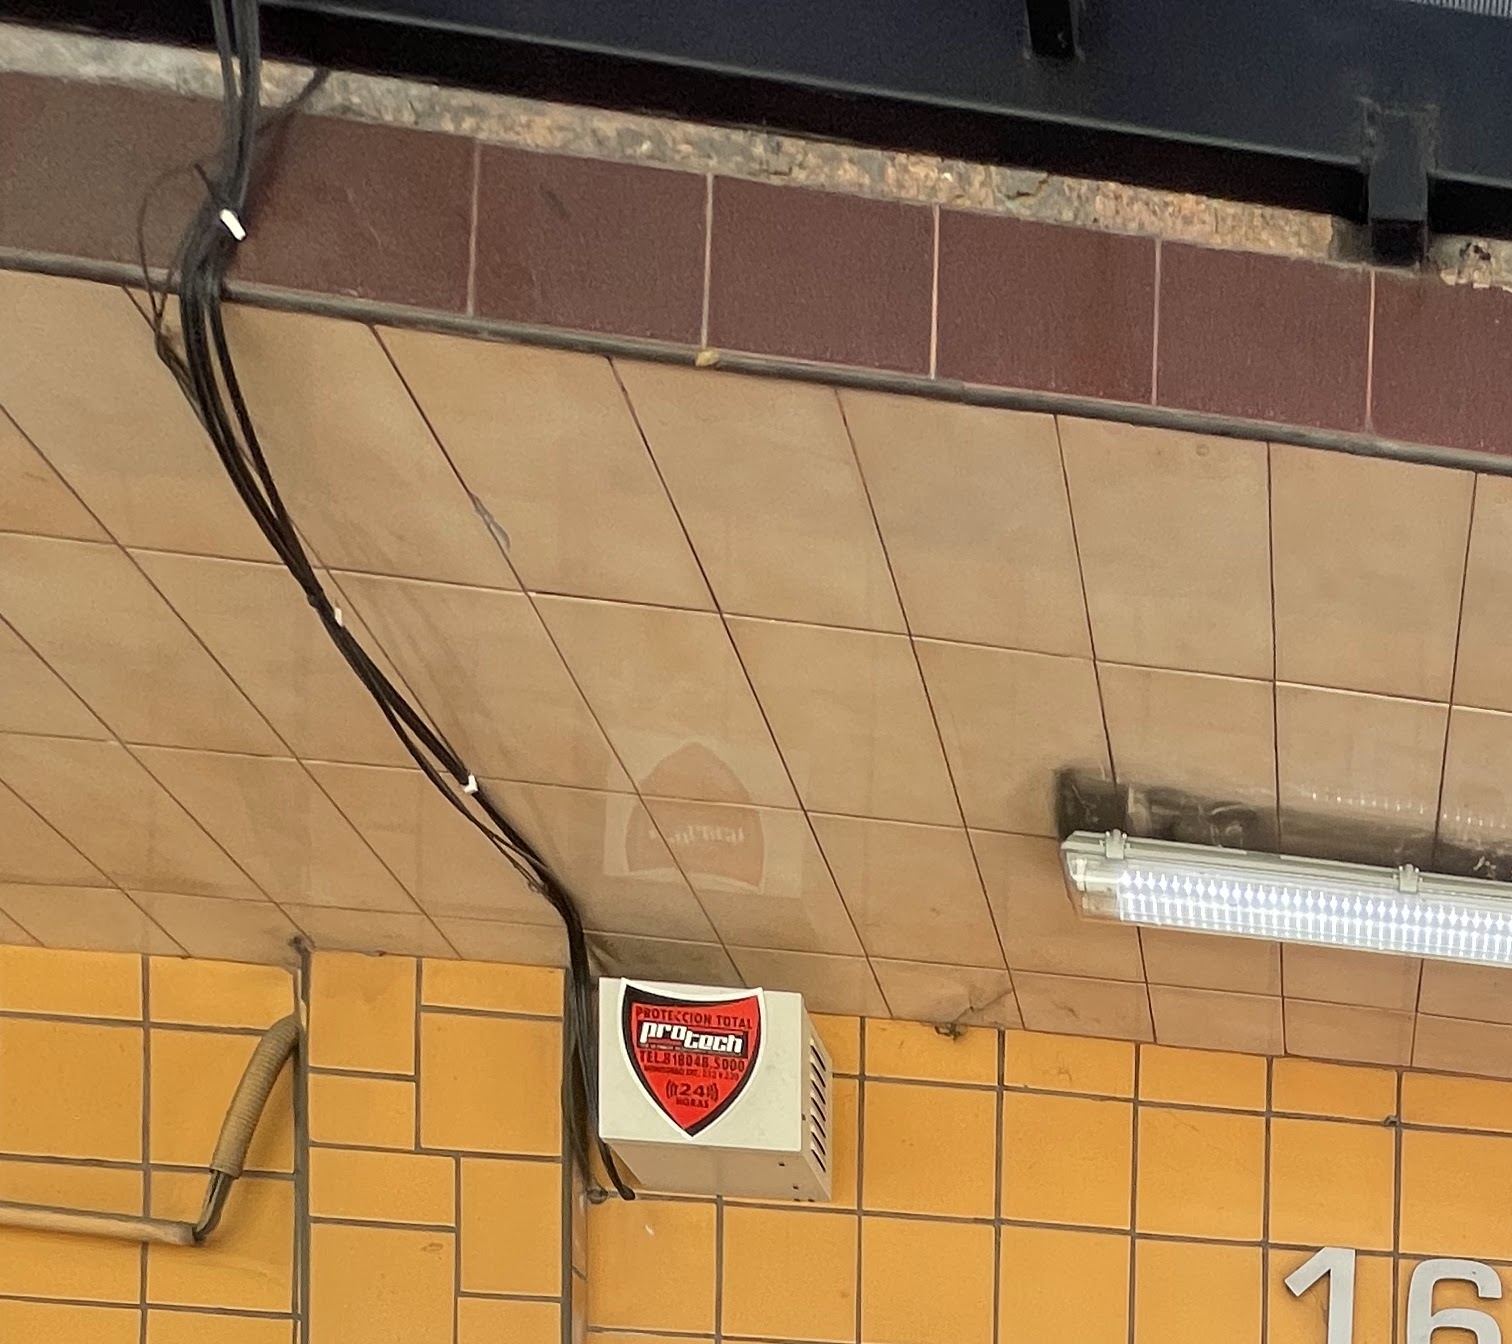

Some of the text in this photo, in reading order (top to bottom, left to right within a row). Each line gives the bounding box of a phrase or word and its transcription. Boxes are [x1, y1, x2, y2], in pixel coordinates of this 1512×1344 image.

[636, 1006, 753, 1030] PROTECCION TOTAL
[680, 1083, 705, 1097] 24
[676, 1098, 709, 1108] HORAS
